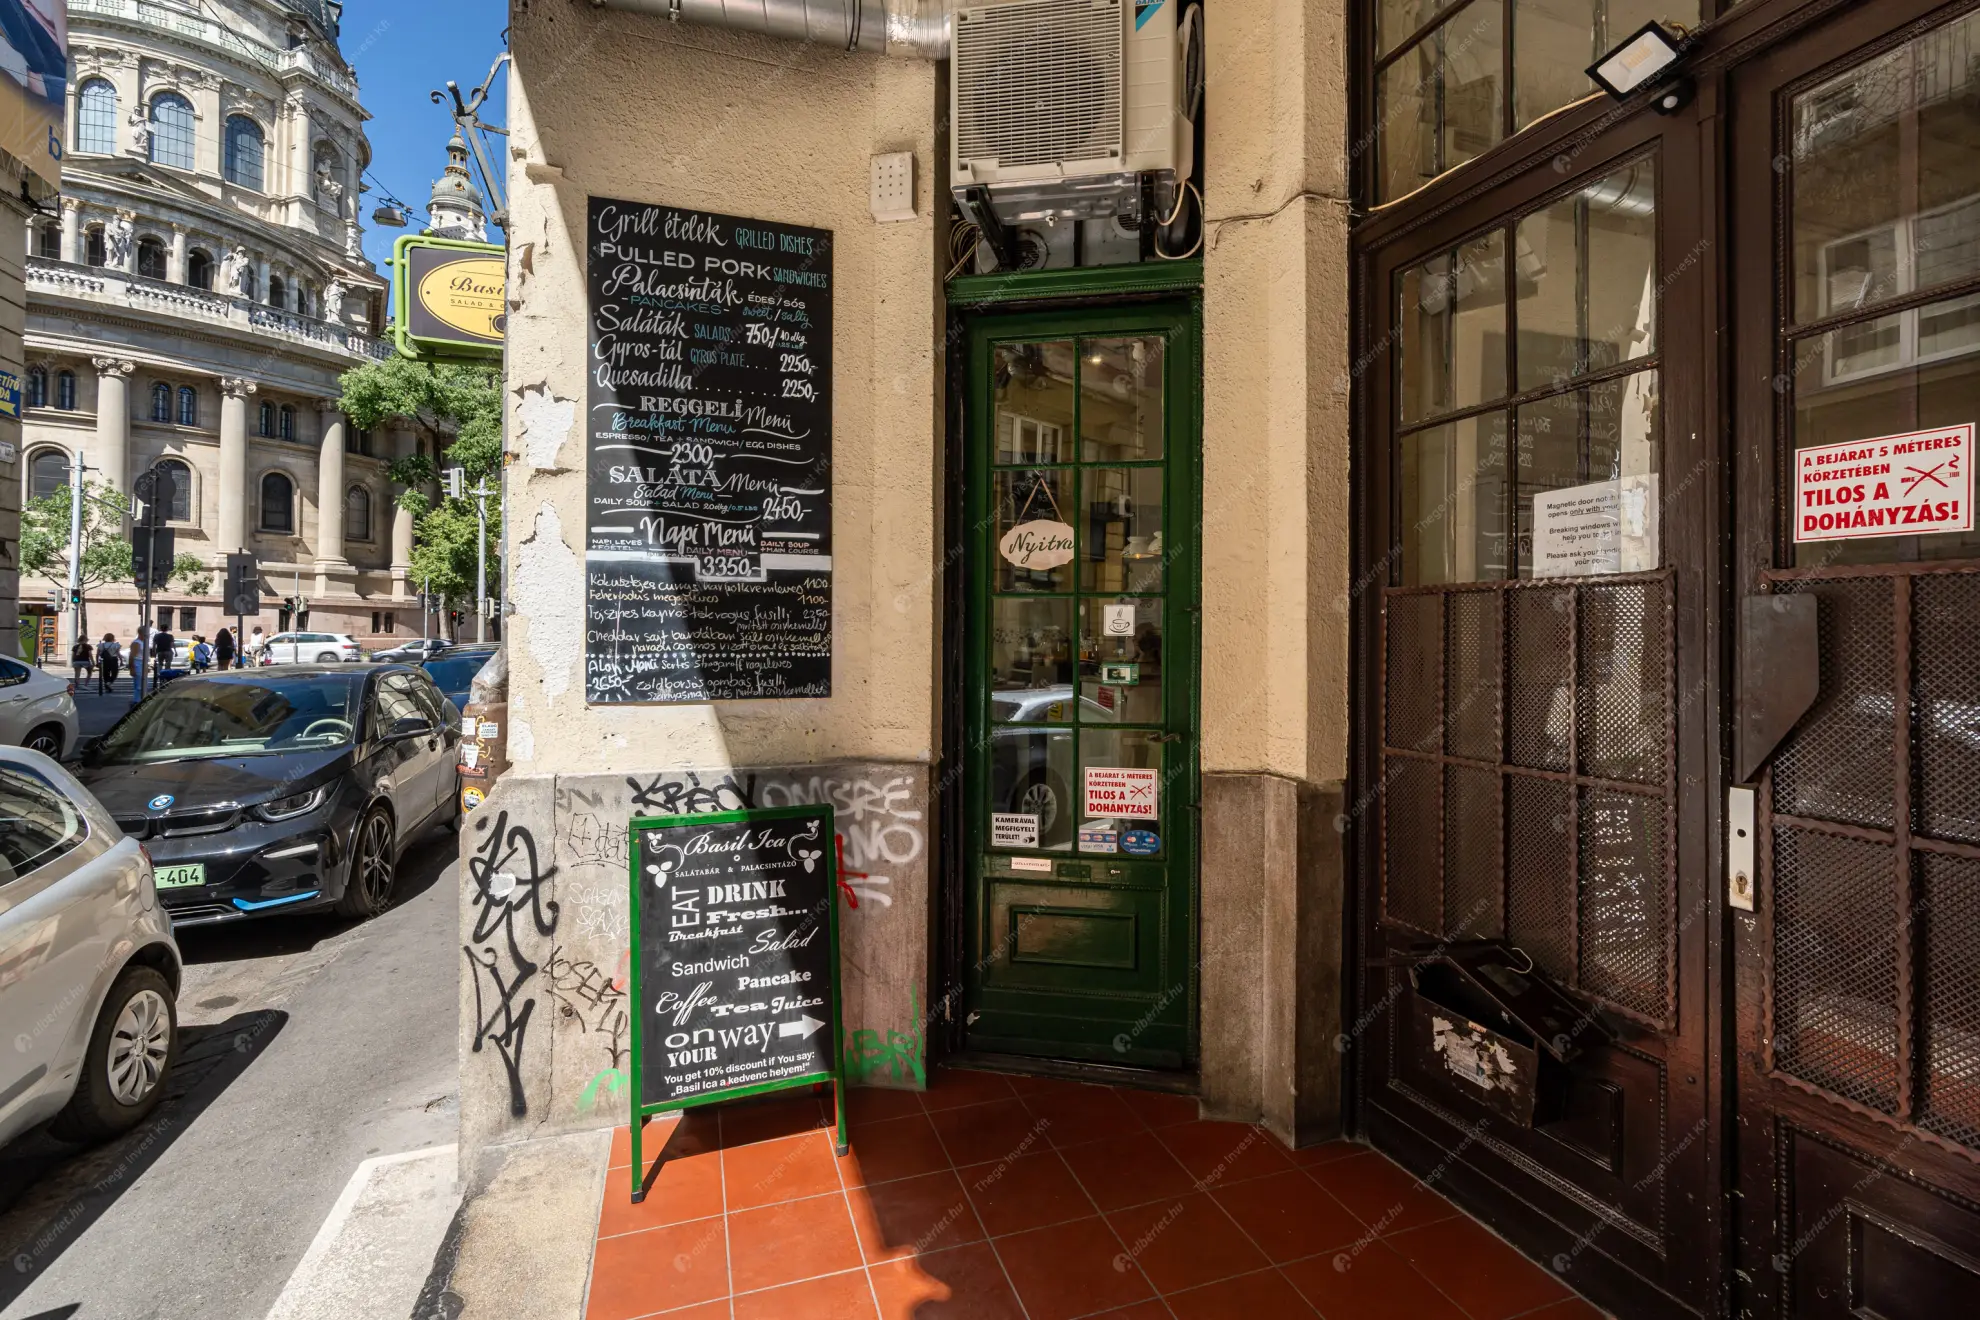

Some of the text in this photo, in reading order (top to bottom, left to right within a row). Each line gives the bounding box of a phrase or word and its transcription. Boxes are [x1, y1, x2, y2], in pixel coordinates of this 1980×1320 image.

[598, 206, 728, 246] Grill ételek
[735, 228, 814, 255] GRILLED DISHES
[600, 243, 827, 288] PULLED PORK SANDWICHES
[602, 264, 743, 306] Palacsinták
[597, 304, 690, 338] Saláták
[595, 334, 683, 366] Gyros-tál
[691, 348, 717, 365] GYROS
[596, 362, 693, 392] Quesadilla
[612, 412, 736, 437] Breakfast Menu
[639, 395, 795, 433] REGGELI Menü
[746, 441, 764, 449] EGG
[766, 441, 801, 451] DISHES
[1804, 435, 1961, 467] A BEJÁRAT 5 MÉTERES
[610, 464, 781, 498] SALÁTA Menü
[1804, 463, 1890, 483] KÖRZETÉBEN
[594, 497, 622, 505] DAILY
[626, 498, 653, 507] SOUP
[662, 501, 699, 509] SALAD
[634, 484, 716, 500] Salad Menu
[1804, 482, 1889, 507] TILOS A
[1547, 501, 1576, 510] Magnetic
[1578, 498, 1593, 506] door
[1570, 508, 1584, 516] only
[1804, 498, 1959, 532] DOHÁNYZÁS!
[640, 516, 756, 554] Napi Menü
[1549, 526, 1578, 534] Breaking
[1580, 522, 1610, 530] windows
[1562, 535, 1576, 543] help
[686, 546, 748, 557] DAILY MENU
[1570, 550, 1581, 558] ask
[1583, 549, 1598, 557] your
[1089, 780, 1126, 788] KÖRZETÉBEN
[1089, 790, 1126, 800] TILOS A
[1089, 801, 1151, 814] DOHÁNYZÁS!
[995, 816, 1035, 824] KAMERÁVAL
[995, 825, 1035, 833] MEGFIGYELT
[684, 830, 752, 856] Basil
[675, 866, 720, 878] SALÁTABÁR
[741, 860, 796, 872] PALACSINTÁZÓ
[707, 879, 786, 905] DRINK
[671, 886, 700, 928] EAT
[668, 925, 743, 942] Breakfast
[749, 927, 818, 954] Salad
[671, 954, 749, 977] Sandwich
[738, 970, 811, 990] Pancake
[656, 981, 718, 1027] Coffee
[710, 995, 823, 1017] Tea Juice
[665, 1022, 776, 1053] on way
[667, 1046, 718, 1067] YOUR
[664, 1075, 683, 1084] You
[685, 1072, 702, 1082] get
[703, 1066, 724, 1076] 10%
[725, 1059, 767, 1074] discount
[769, 1057, 775, 1065] if
[777, 1055, 795, 1064] You
[702, 1080, 718, 1089] Ica
[728, 1072, 768, 1085] kedvenc
